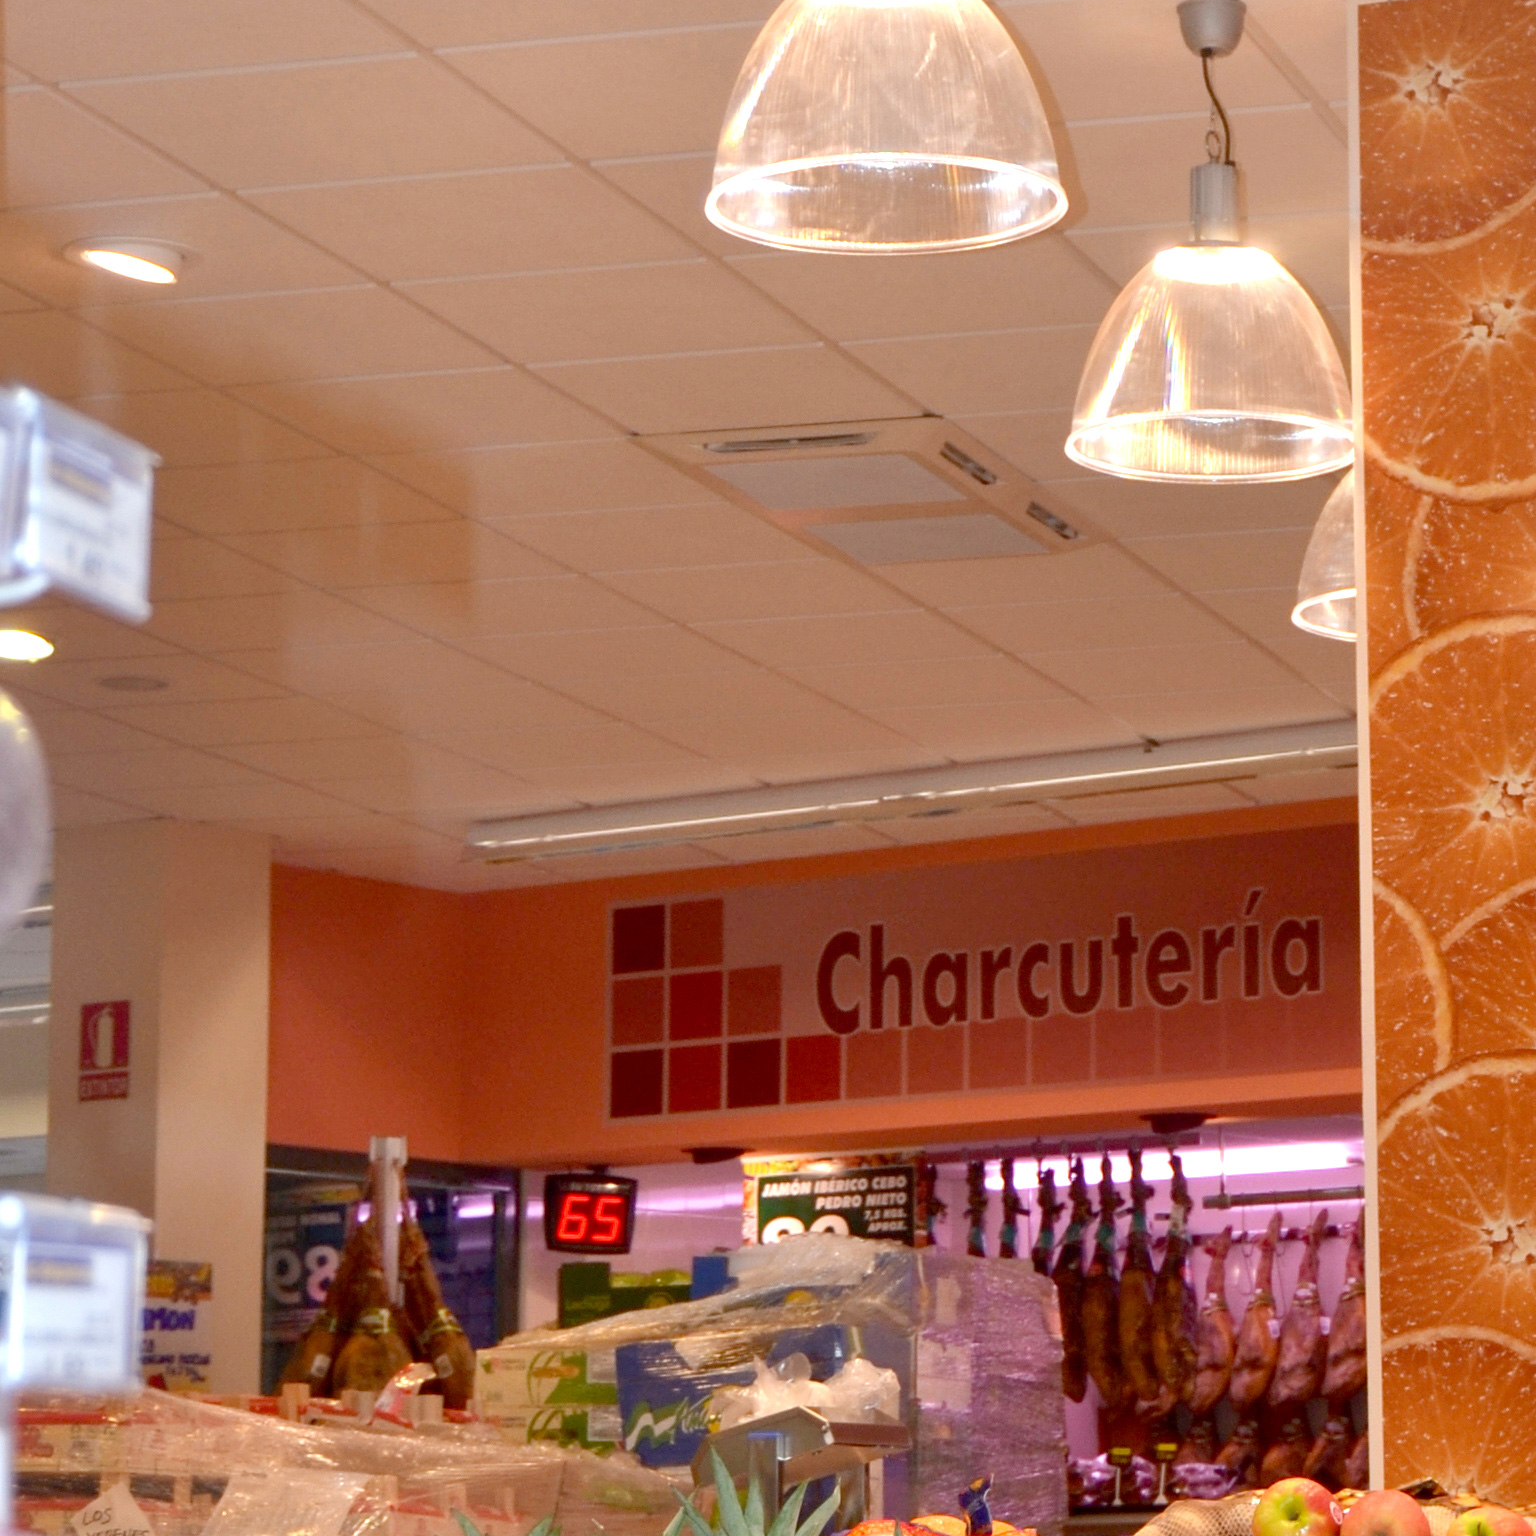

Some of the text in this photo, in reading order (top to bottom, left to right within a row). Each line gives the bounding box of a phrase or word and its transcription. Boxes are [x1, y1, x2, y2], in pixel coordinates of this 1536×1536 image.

[815, 888, 1322, 1035] Charcutería
[761, 1175, 908, 1198] JAMÓN IBÉRICO CEBO
[815, 1192, 908, 1211] PEDRO NIETO
[556, 1193, 624, 1243] 65
[83, 1507, 112, 1526] LOS
